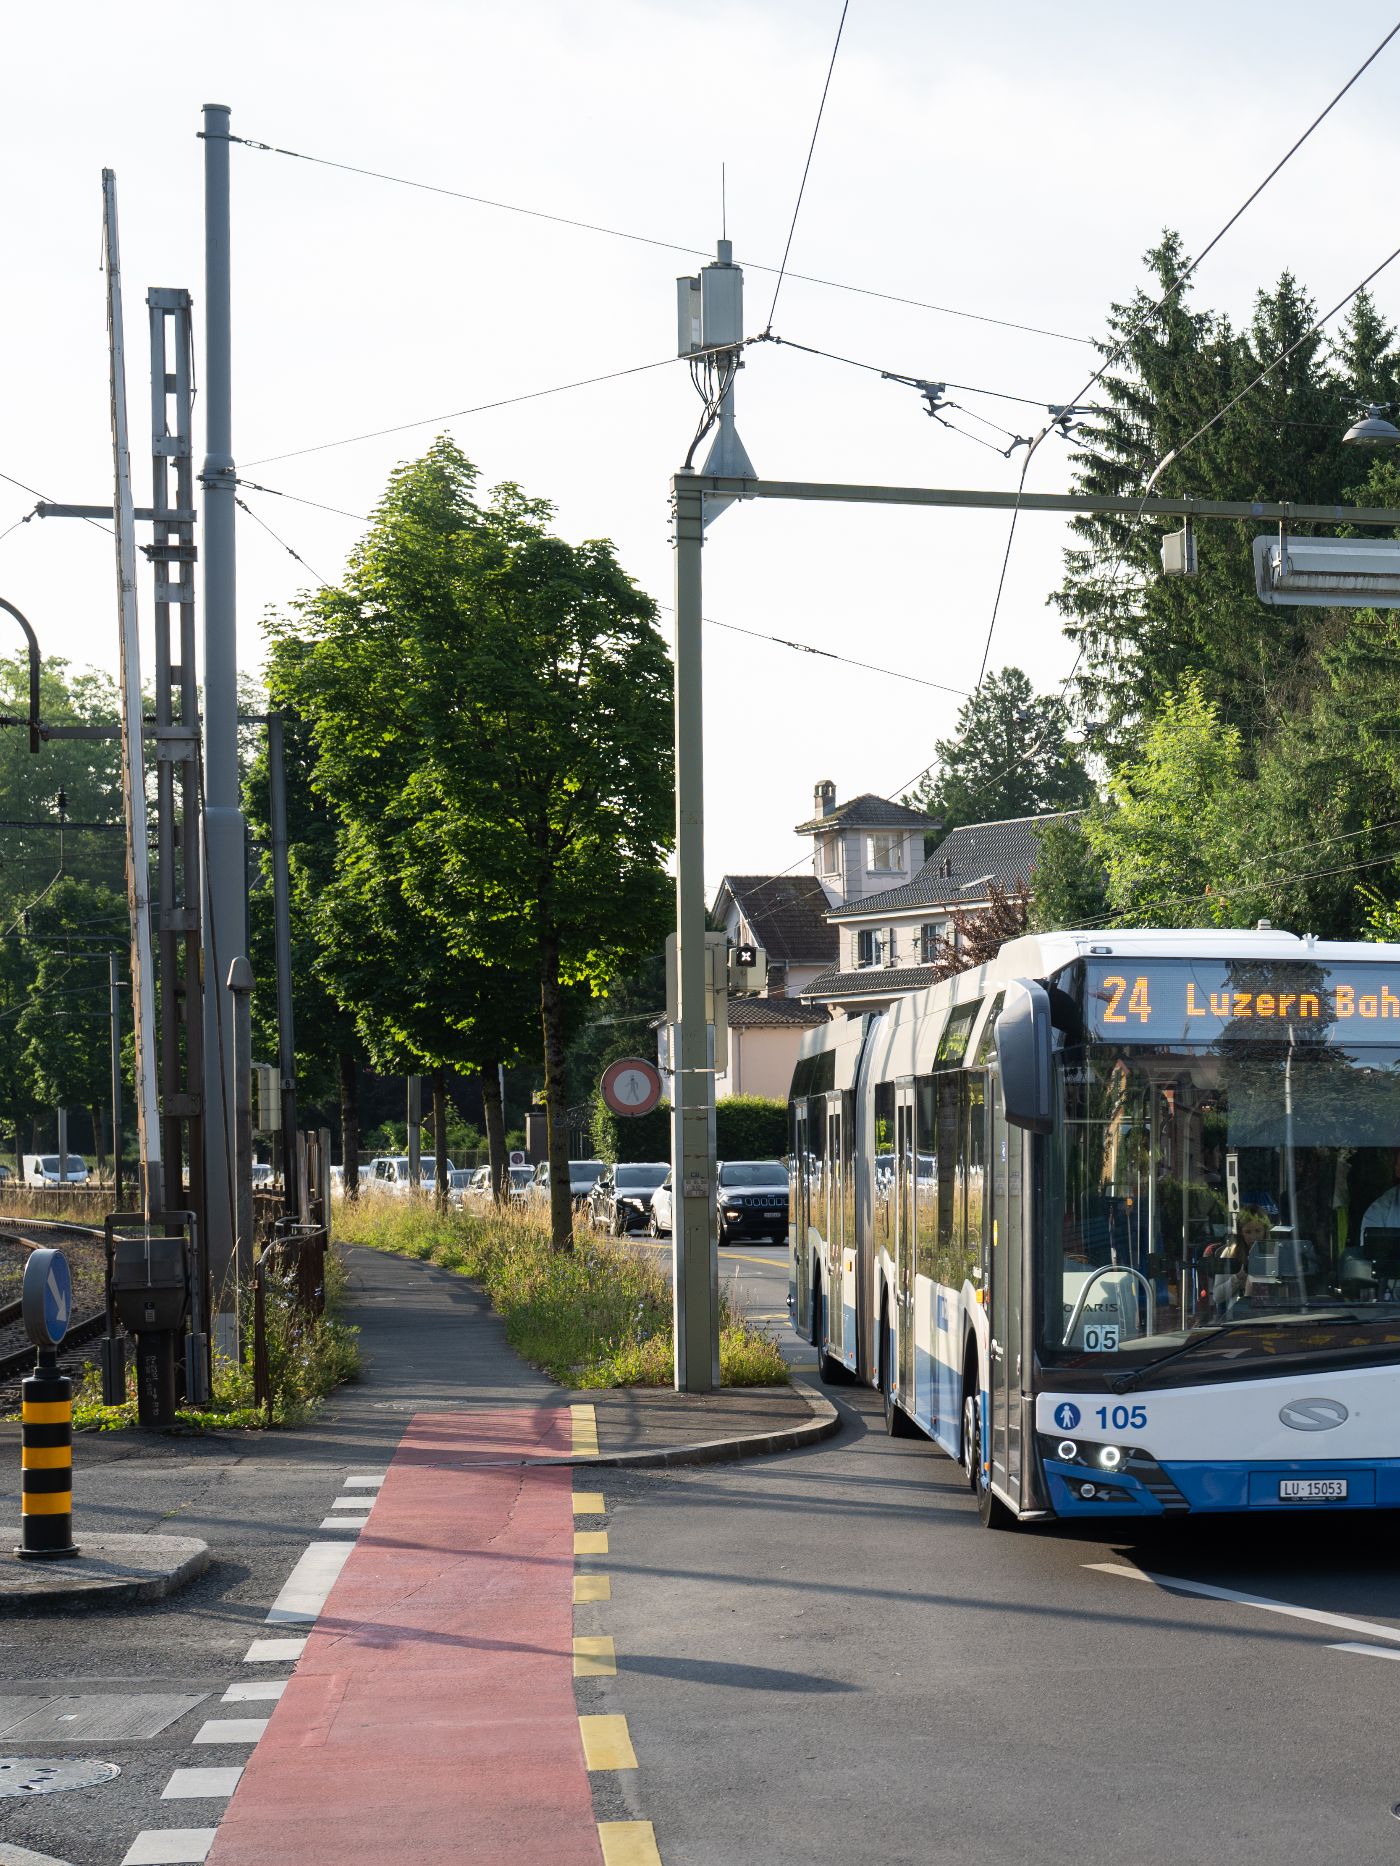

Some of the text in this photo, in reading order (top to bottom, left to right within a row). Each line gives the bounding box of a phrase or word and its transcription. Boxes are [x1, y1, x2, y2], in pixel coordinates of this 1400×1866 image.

[1103, 976, 1152, 1023] 24
[1187, 983, 1319, 1017] Luzern
[1086, 1331, 1116, 1349] 05
[1096, 1405, 1147, 1429] 105
